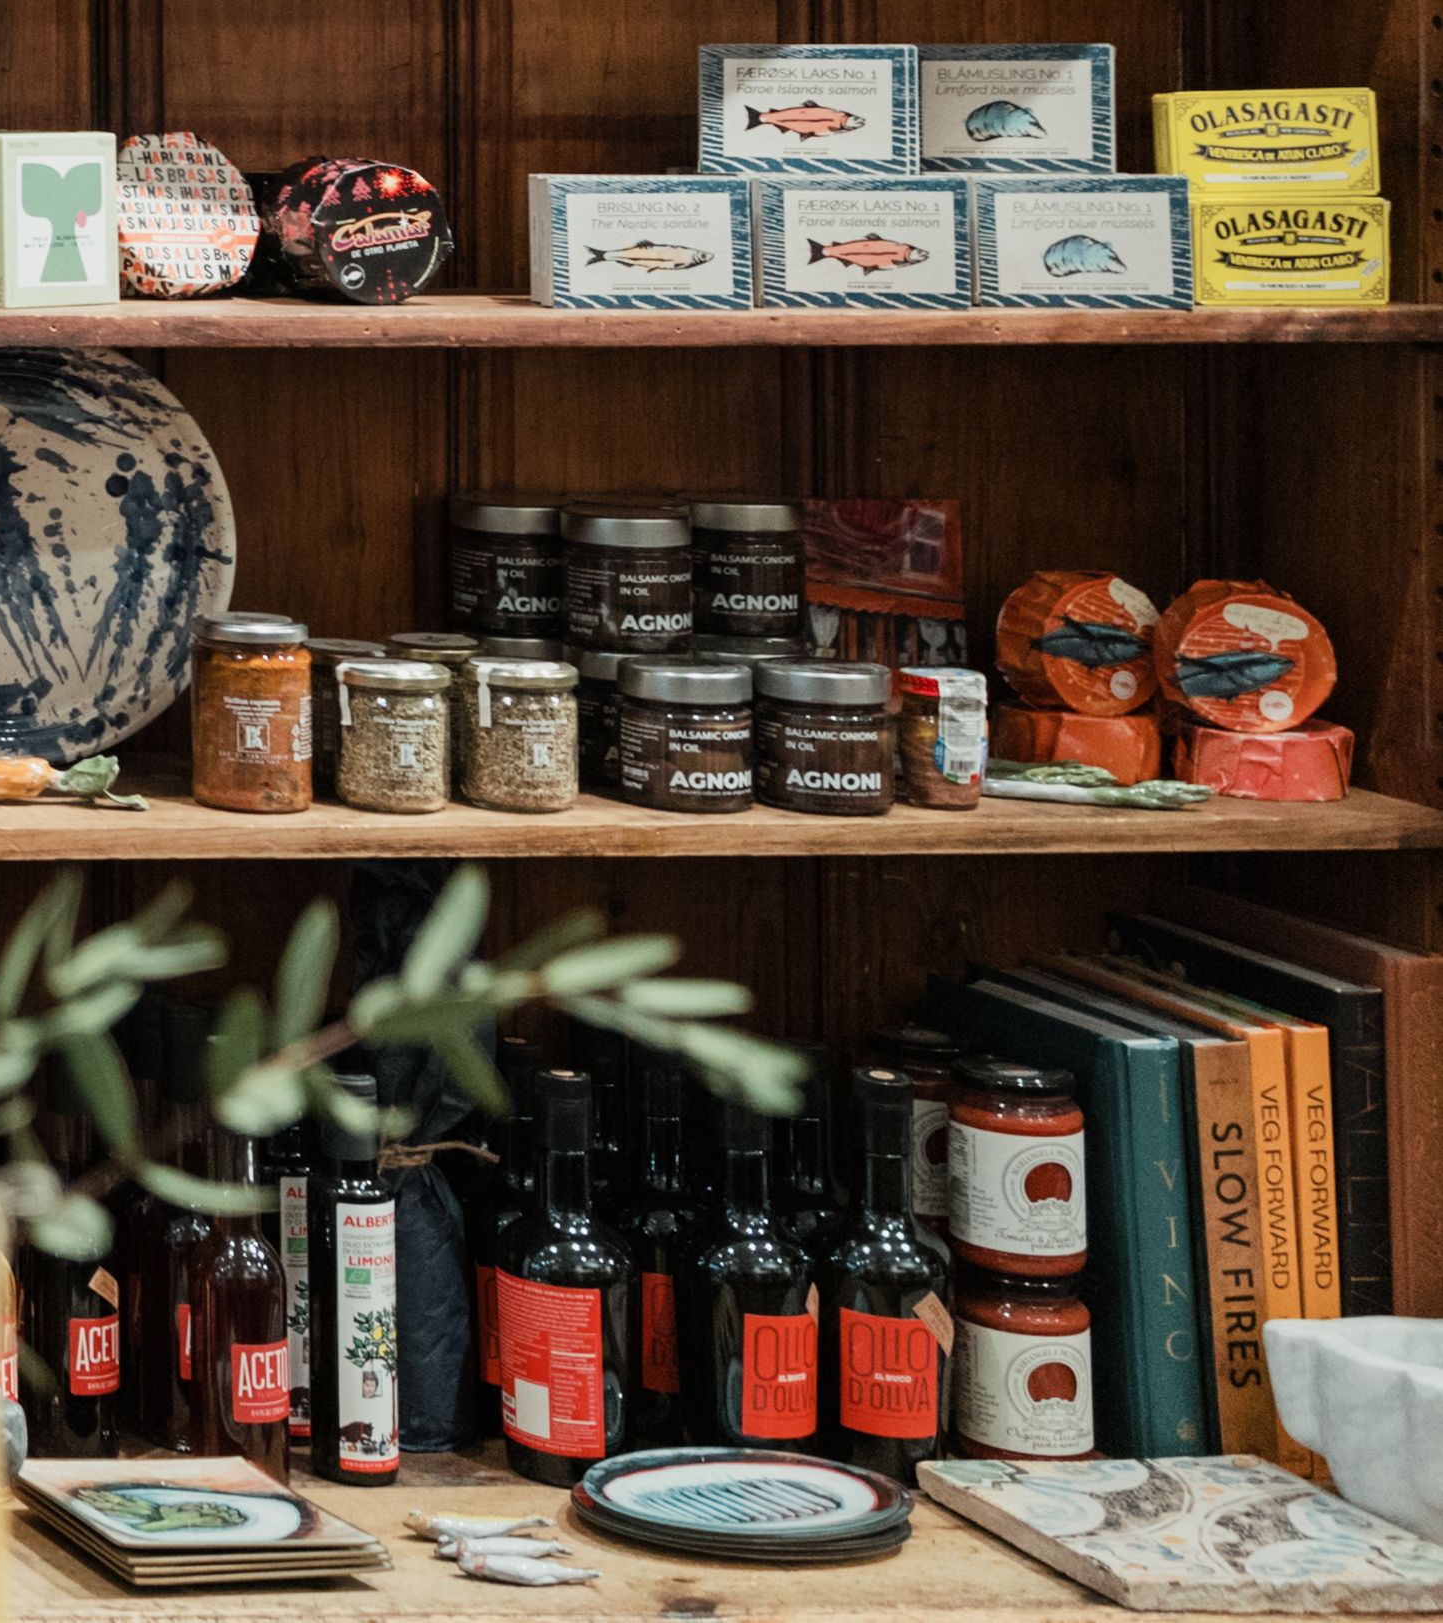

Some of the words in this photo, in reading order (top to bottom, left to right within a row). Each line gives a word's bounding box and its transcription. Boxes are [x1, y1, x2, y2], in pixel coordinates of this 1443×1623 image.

[736, 67, 799, 80] FÆRØSK
[801, 67, 841, 80] LAKS
[844, 67, 866, 80] No.
[870, 68, 878, 80] 1
[937, 65, 1037, 80] BLÅMUSLING
[1040, 67, 1062, 80] No.
[1067, 67, 1074, 80] 1
[736, 83, 775, 95] Faroe
[777, 83, 824, 95] Islands
[828, 83, 878, 95] salmon
[935, 83, 988, 97] Limfjord
[990, 83, 1020, 95] blue
[1024, 83, 1077, 95] mussels
[1190, 101, 1356, 134] OLASAGASTI
[1208, 146, 1264, 161] VENTRESCA
[1306, 144, 1342, 159] CLARO
[167, 167, 227, 184] BRASAS
[597, 202, 664, 214] BRISLING
[667, 202, 689, 214] No.
[693, 202, 701, 214] 2
[798, 200, 861, 213] FÆRØSK
[863, 200, 903, 213] LAKS
[906, 200, 928, 213] No.
[933, 201, 941, 213] 1
[591, 218, 615, 229] The
[618, 218, 659, 229] Nordic
[661, 218, 710, 229] sardine
[798, 215, 838, 227] Faroe
[840, 215, 888, 227] Islands
[891, 215, 941, 227] salmon
[1214, 209, 1369, 241] OLASAGASTI
[332, 211, 432, 252] Calamar
[385, 239, 420, 252] PLANETA
[711, 592, 798, 612] AGNONI
[669, 728, 720, 740] BALSAMIC
[785, 727, 838, 741] BALSAMIC
[839, 731, 879, 742] ONIONS
[669, 742, 680, 752] IN
[681, 742, 701, 753] OIL
[785, 740, 796, 749] IN
[798, 741, 816, 752] OIL
[669, 770, 752, 791] AGNONI
[786, 768, 881, 791] AGNONI
[1259, 1084, 1282, 1144] VEG
[1306, 1084, 1328, 1144] VEG
[1211, 1121, 1252, 1249] SLOW
[1264, 1149, 1291, 1291] FORWARD
[1310, 1149, 1333, 1291] FORWARD
[1154, 1159, 1194, 1362] VINO
[1222, 1266, 1263, 1388] FIRES
[754, 1321, 817, 1381] OLIO
[849, 1320, 931, 1377] OLIO
[237, 1346, 288, 1399] ACETO
[849, 1376, 931, 1413] D'OLIVA
